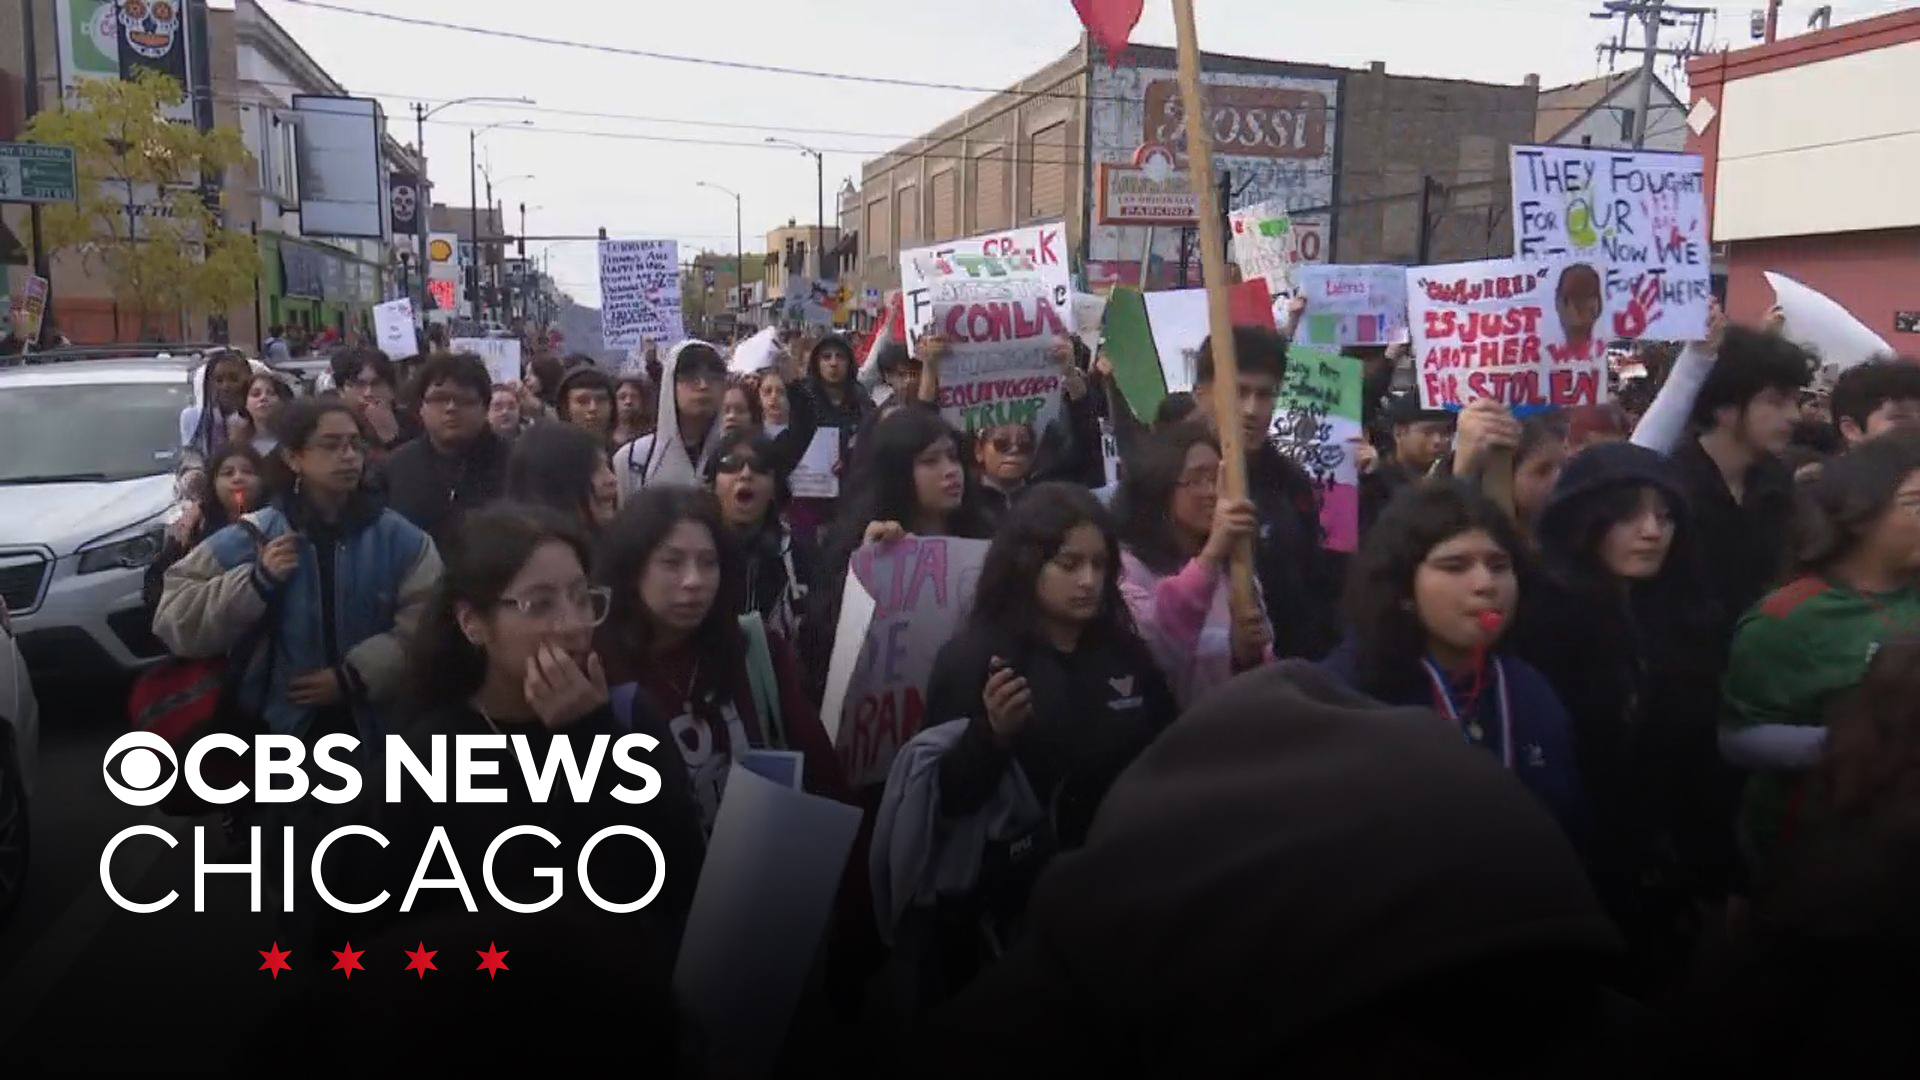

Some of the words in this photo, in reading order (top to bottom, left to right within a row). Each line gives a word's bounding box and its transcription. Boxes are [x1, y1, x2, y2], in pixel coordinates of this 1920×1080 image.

[1516, 151, 1595, 193] THEY
[1610, 156, 1704, 194] FOUGHT
[1126, 206, 1191, 216] PARKING
[1520, 201, 1559, 234] FOR
[1566, 198, 1634, 235] OUR
[1602, 235, 1648, 263] NOW
[1655, 234, 1701, 265] WE
[1458, 307, 1542, 343] JUST
[1424, 335, 1542, 370] ANOTHER
[962, 397, 1046, 432] TRUMP
